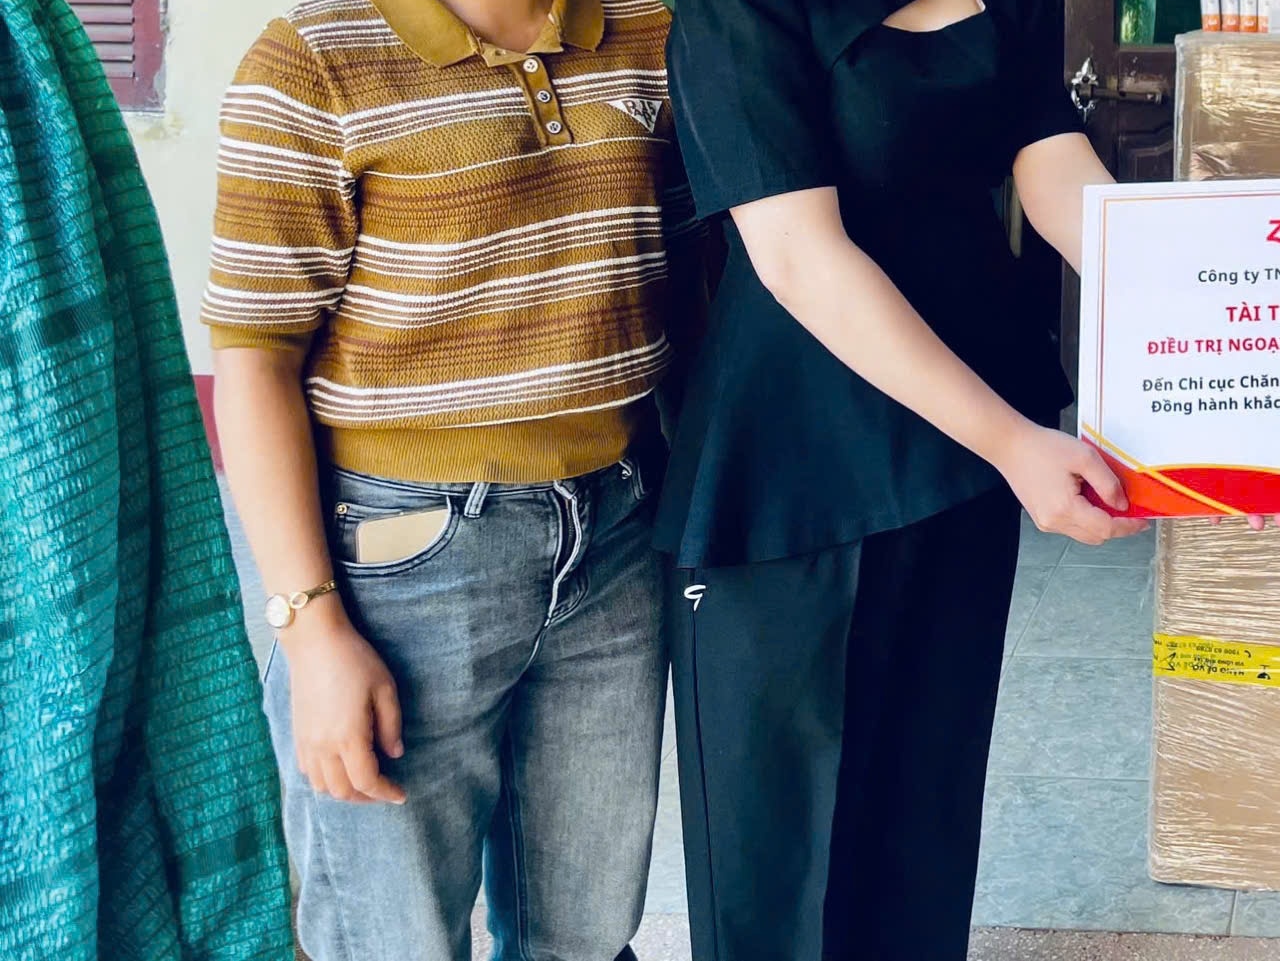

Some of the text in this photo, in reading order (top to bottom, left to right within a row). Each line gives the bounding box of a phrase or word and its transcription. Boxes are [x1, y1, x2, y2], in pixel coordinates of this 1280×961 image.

[1198, 269, 1239, 284] Công
[1244, 268, 1259, 285] ty
[1226, 302, 1261, 322] TÀI
[1147, 336, 1189, 354] ĐIỀU
[1195, 339, 1222, 356] TRỊ
[1143, 377, 1173, 391] Đến
[1178, 376, 1203, 390] Chi
[1208, 378, 1235, 392] cục
[1240, 374, 1279, 388] Chăn
[1151, 399, 1193, 415] Đồng
[1198, 397, 1238, 411] hành
[1244, 395, 1280, 410] khắc
